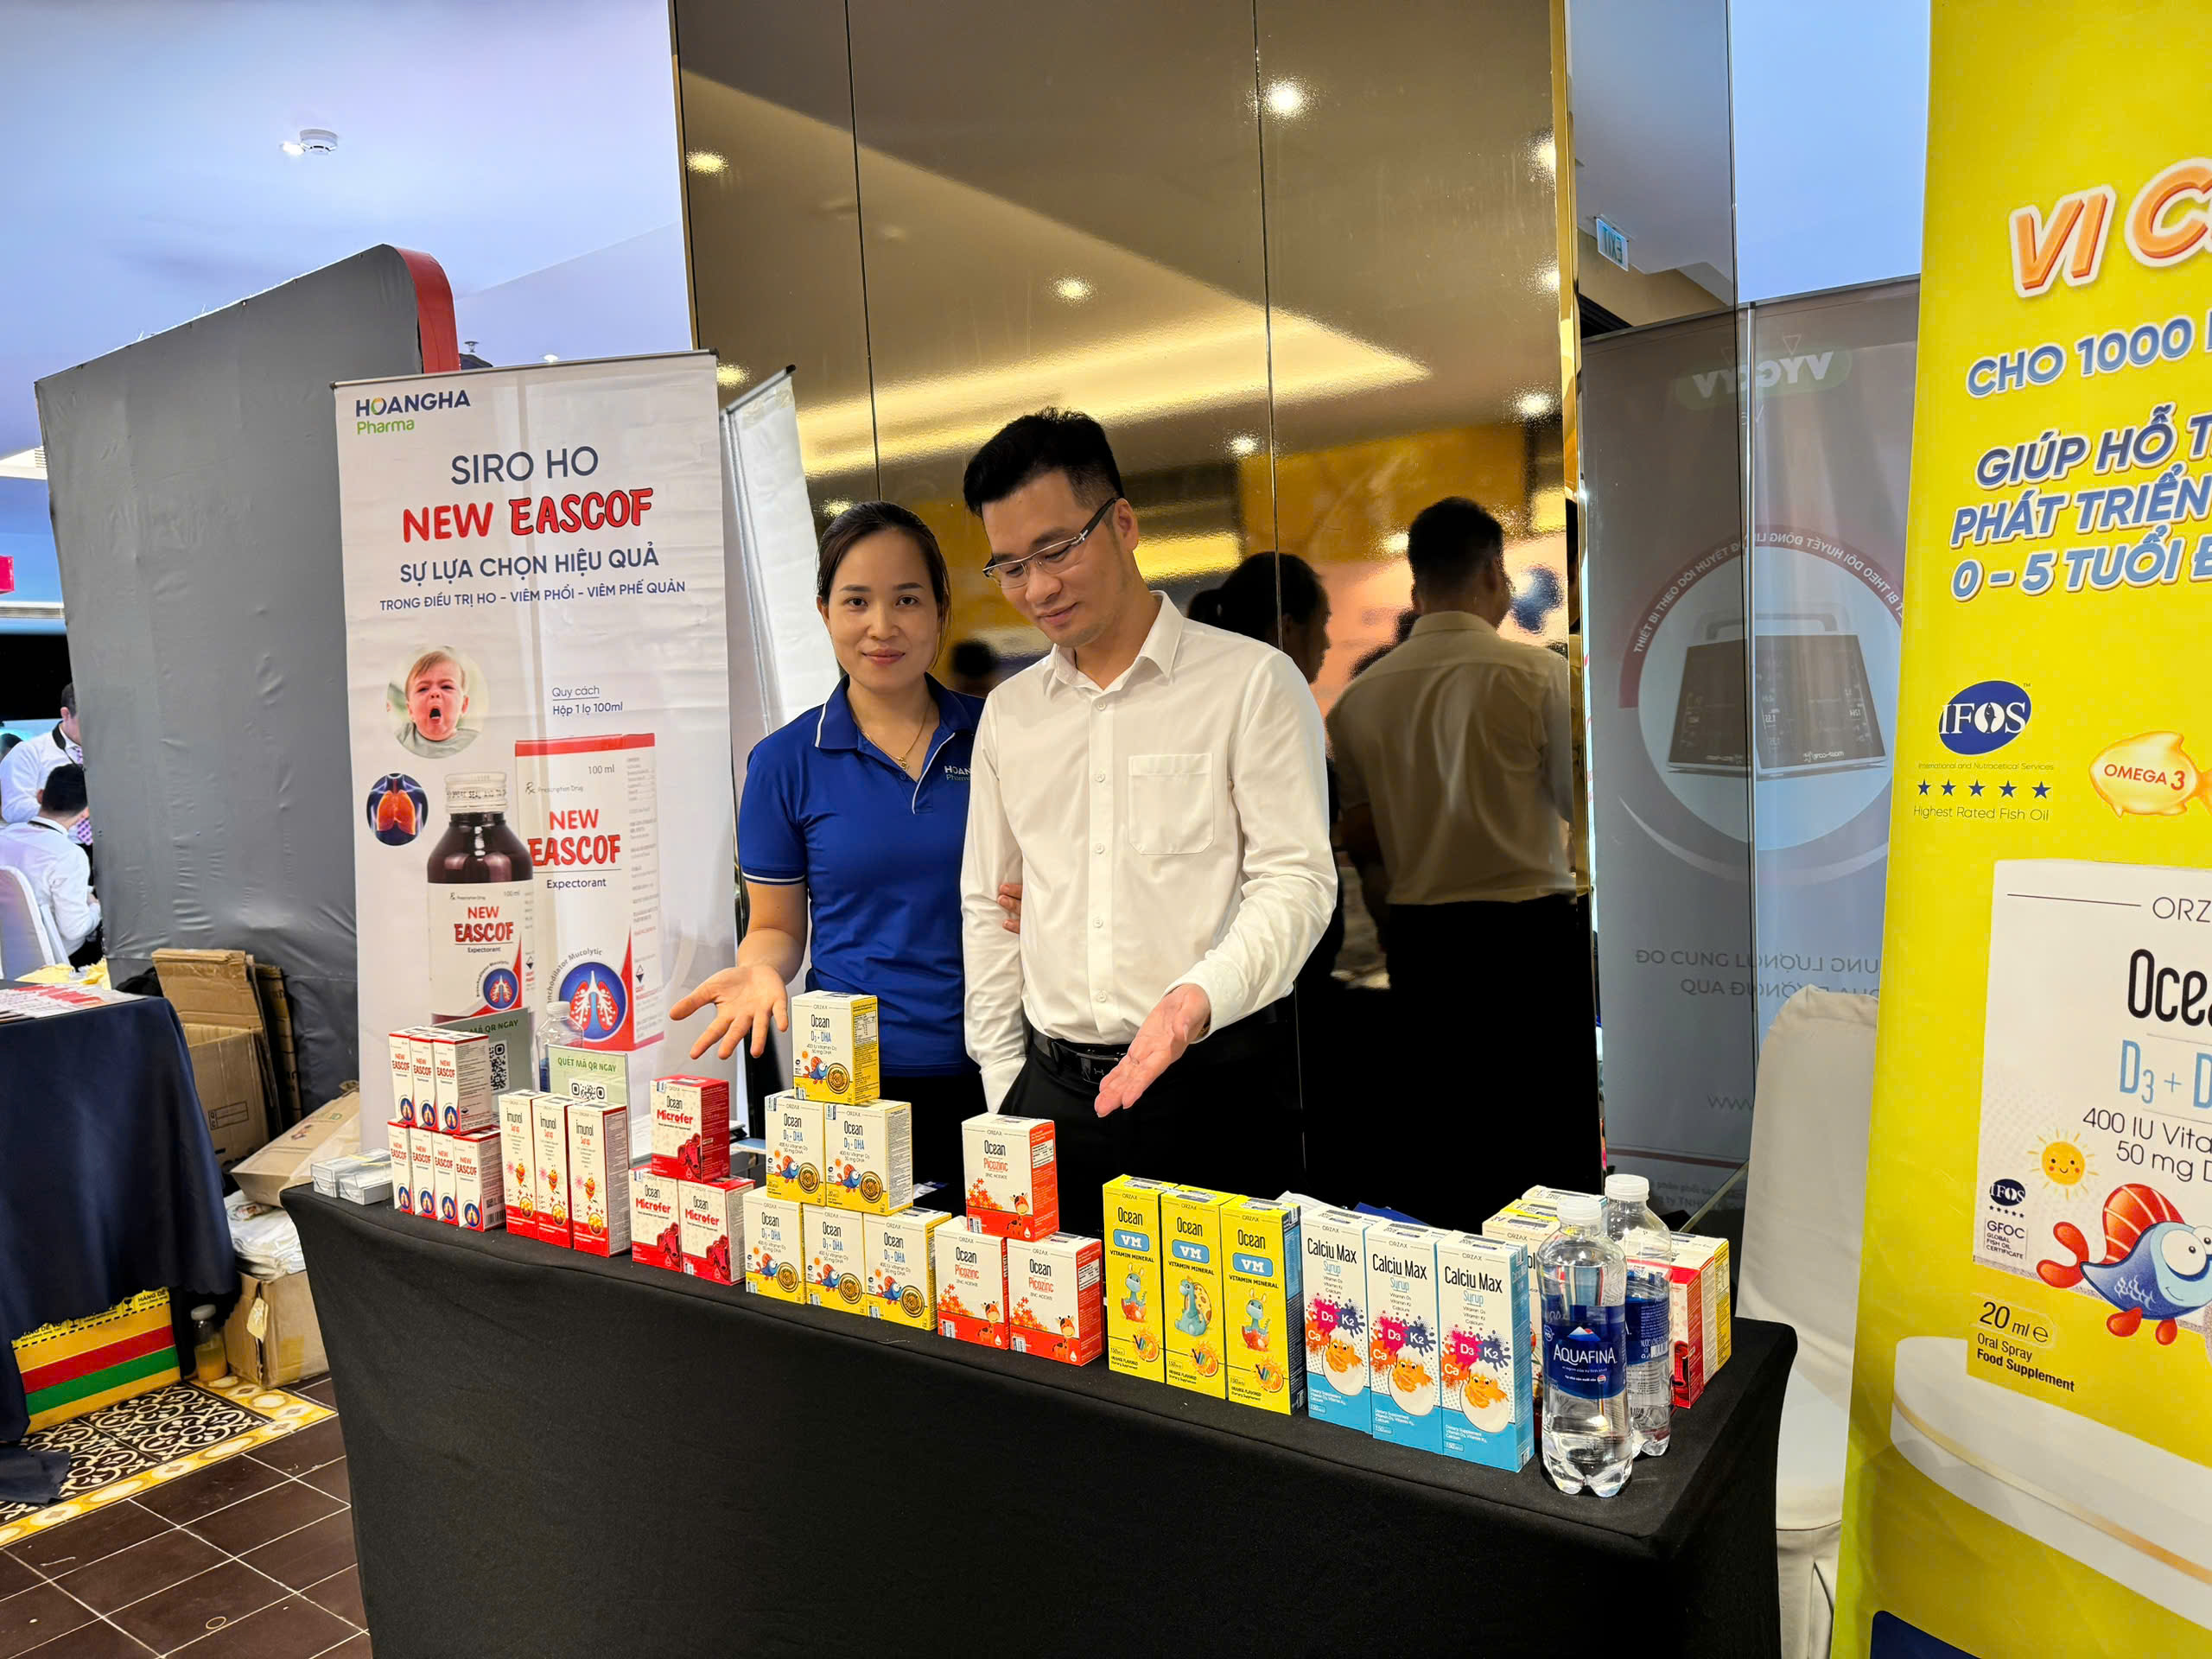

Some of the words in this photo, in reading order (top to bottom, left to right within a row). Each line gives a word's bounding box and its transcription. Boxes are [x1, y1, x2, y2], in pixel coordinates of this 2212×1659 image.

[2012, 189, 2113, 294] VI
[1967, 344, 2064, 397] CHO
[2077, 318, 2194, 377] 1000
[356, 390, 470, 417] HOANGHA
[357, 418, 415, 435] Pharma
[1976, 431, 2088, 487] GIÚP
[2095, 402, 2176, 474] HỖ
[451, 451, 534, 485] SIRO
[546, 446, 599, 478] HO
[1951, 489, 2067, 548] PHÁT
[2076, 463, 2212, 532] TRIỂN
[403, 502, 493, 543] NEW
[509, 487, 653, 536] EASCOF
[400, 560, 427, 586] SỰ
[433, 558, 473, 584] LỰA
[480, 555, 547, 580] CHỌN
[555, 548, 602, 576] HIỆU
[609, 542, 658, 569] QUẢ
[1952, 560, 1982, 601] 0
[2021, 551, 2056, 594] 5
[2065, 524, 2185, 590] TUỔI
[380, 598, 421, 611] TRONG
[455, 594, 474, 607] TRỊ
[477, 593, 496, 604] HO
[511, 588, 542, 601] VIÊM
[588, 582, 619, 597] VIÊM
[621, 579, 644, 595] PHẾ
[1656, 587, 1679, 611] THEO
[552, 686, 572, 698] Quy
[575, 685, 600, 696] cách
[553, 704, 572, 717] Hộp
[576, 704, 580, 714] 1
[581, 703, 591, 716] lọ
[594, 702, 623, 713] 100ml
[1940, 702, 2027, 734] IFOS
[588, 766, 603, 774] 100
[604, 764, 614, 773] ml
[2104, 764, 2167, 785] OMEGA
[2171, 771, 2185, 791] 3
[549, 808, 600, 830] NEW
[1914, 806, 1953, 817] Highest
[1957, 806, 1995, 818] Rated
[1999, 808, 2024, 819] Fish
[2031, 809, 2050, 821] Oil
[527, 835, 620, 866] EASCOF
[546, 878, 607, 890] Expectorant
[467, 906, 499, 919] NEW
[454, 921, 513, 942] EASCOF
[569, 947, 602, 962] Mucolytic
[1636, 950, 1665, 964] ĐO
[1671, 950, 1729, 968] CUNG
[1681, 978, 1725, 995] QUA
[2127, 949, 2212, 1027] Oce
[485, 1024, 496, 1033] QR
[498, 1020, 518, 1030] NGAY
[810, 1014, 830, 1028] Ocean
[392, 1060, 410, 1071] EASCOF
[413, 1065, 431, 1076] EASCOF
[558, 1057, 575, 1067] QUÉT
[588, 1061, 598, 1071] QR
[599, 1063, 616, 1071] NGAY
[437, 1067, 455, 1078] EASCOF
[667, 1096, 683, 1109] Ocean
[657, 1109, 694, 1124] Microfer
[784, 1114, 802, 1128] Ocean
[2083, 1108, 2125, 1133] 400
[2133, 1116, 2153, 1140] IU
[844, 1121, 863, 1135] Ocean
[984, 1141, 1006, 1156] Ocean
[435, 1157, 453, 1168] EASCOF
[983, 1158, 1007, 1172] Picozinc
[2116, 1141, 2144, 1165] 50
[2152, 1153, 2193, 1182] mg
[456, 1164, 477, 1175] EASCOF
[645, 1185, 660, 1198] Ocean
[1990, 1183, 2025, 1204] IFOS
[636, 1198, 671, 1214] Microfer
[693, 1196, 709, 1210] Ocean
[685, 1209, 719, 1226] Microfer
[761, 1212, 779, 1227] Ocean
[1118, 1207, 1143, 1225] Ocean
[823, 1222, 841, 1237] Ocean
[1177, 1217, 1203, 1236] Ocean
[1986, 1220, 2025, 1239] GFOC
[884, 1232, 903, 1249] Ocean
[1121, 1235, 1142, 1248] VM
[1237, 1230, 1265, 1249] Ocean
[1986, 1233, 2011, 1243] GLOBAL
[956, 1247, 977, 1263] Ocean
[1110, 1250, 1130, 1259] VITAMIN
[1132, 1255, 1154, 1263] MINERAL
[1179, 1245, 1201, 1260] VM
[1307, 1237, 1335, 1259] Calciu
[1337, 1245, 1357, 1263] Max
[1986, 1245, 2024, 1259] CERTIFICATE
[955, 1265, 979, 1279] Picozinc
[1030, 1259, 1052, 1276] Ocean
[1168, 1261, 1190, 1270] VITAMIN
[1192, 1266, 1214, 1275] MINERAL
[1241, 1259, 1264, 1273] VM
[1324, 1261, 1341, 1274] Syrup
[1372, 1254, 1402, 1275] Calciu
[1405, 1260, 1427, 1280] Max
[1029, 1277, 1053, 1293] Picozinc
[1229, 1274, 1252, 1284] VITAMIN
[1253, 1280, 1279, 1288] MINERAL
[1390, 1277, 1409, 1292] Syrup
[1445, 1266, 1476, 1288] Calciu
[1478, 1273, 1502, 1294] Max
[1463, 1290, 1484, 1305] Syrup
[1321, 1313, 1333, 1323] D3
[1342, 1315, 1354, 1326] K2
[1980, 1301, 2011, 1329] 20
[2012, 1321, 2031, 1337] ml
[1307, 1331, 1321, 1341] Ca
[1388, 1330, 1401, 1341] D3
[1410, 1333, 1424, 1344] K2
[1373, 1349, 1387, 1360] Ca
[1460, 1344, 1474, 1355] D3
[1484, 1348, 1498, 1359] K2
[1554, 1344, 1617, 1365] AQUAFINA
[1978, 1333, 1998, 1349] Oral
[2001, 1342, 2033, 1363] Spray
[1444, 1364, 1459, 1376] Ca
[1977, 1349, 2003, 1366] Food
[2006, 1358, 2075, 1392] Supplement
